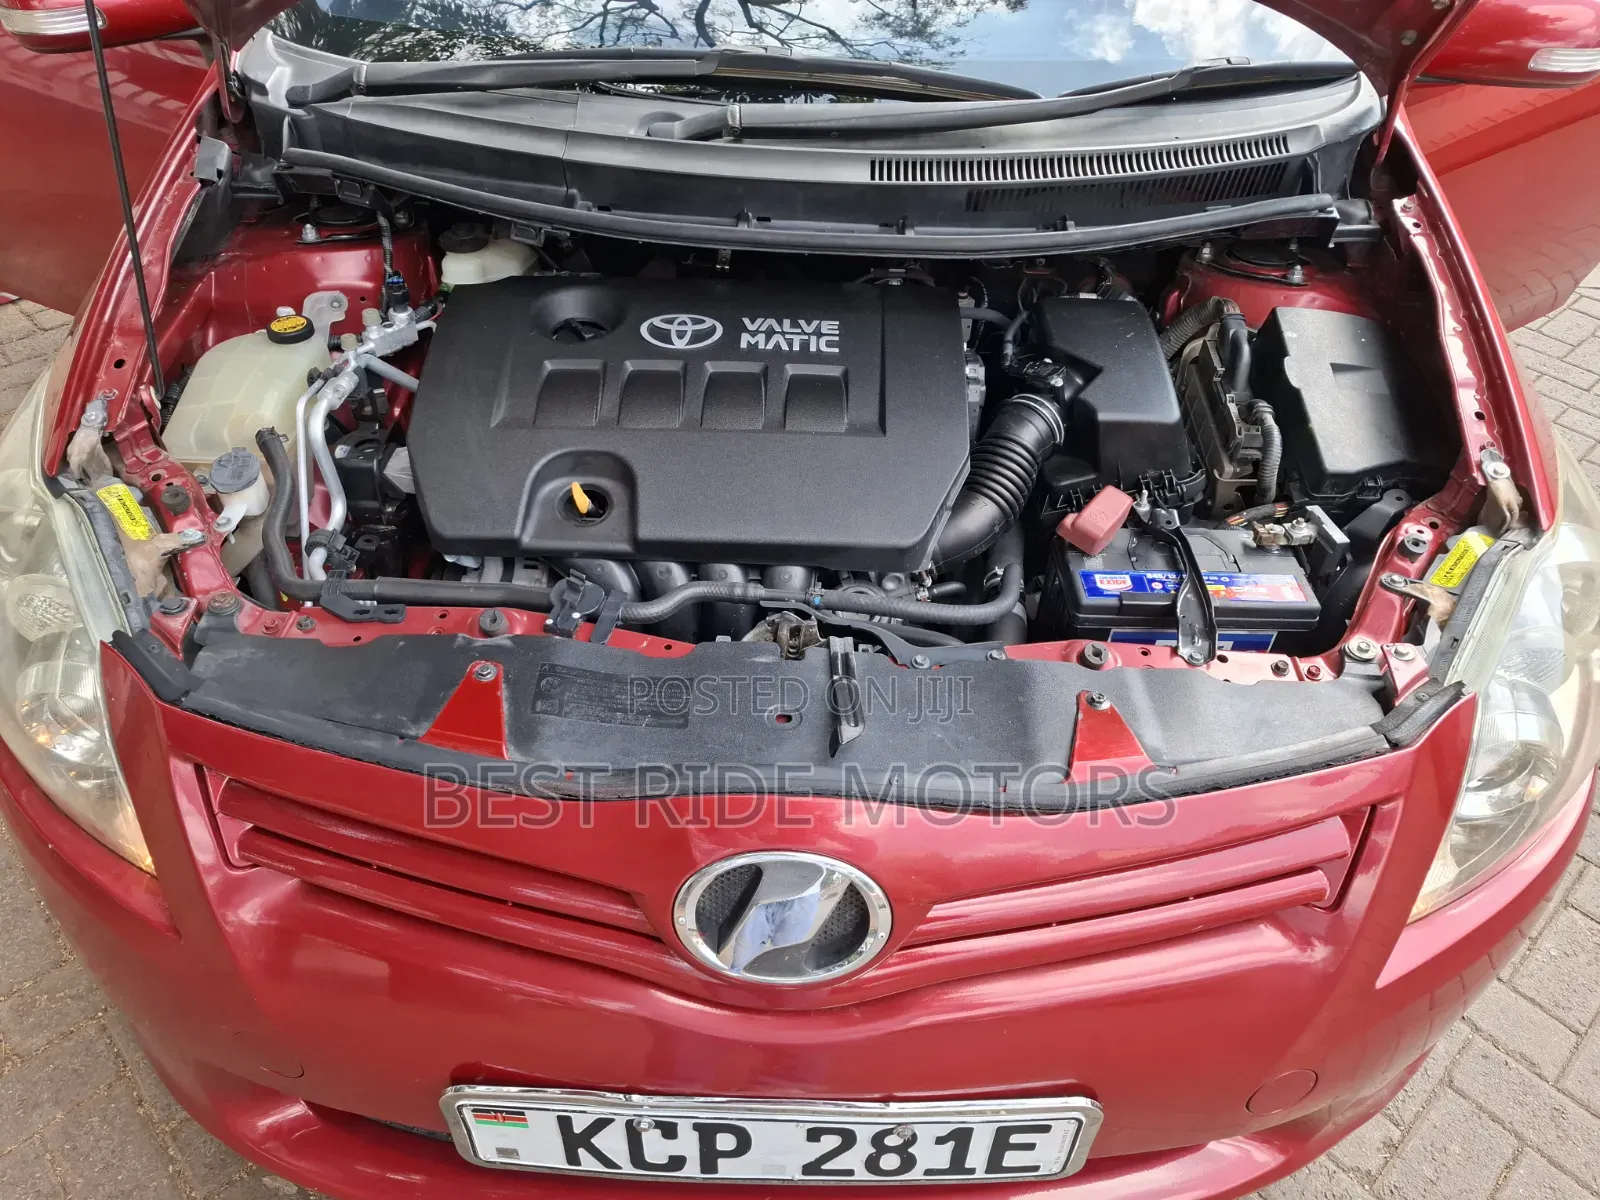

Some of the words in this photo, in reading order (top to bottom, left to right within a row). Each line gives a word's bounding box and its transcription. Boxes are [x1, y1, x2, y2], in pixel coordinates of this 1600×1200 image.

[741, 317, 840, 335] VALVE
[740, 333, 840, 353] MATIC
[556, 1114, 753, 1175] KCP
[801, 1123, 1053, 1178] 281E
